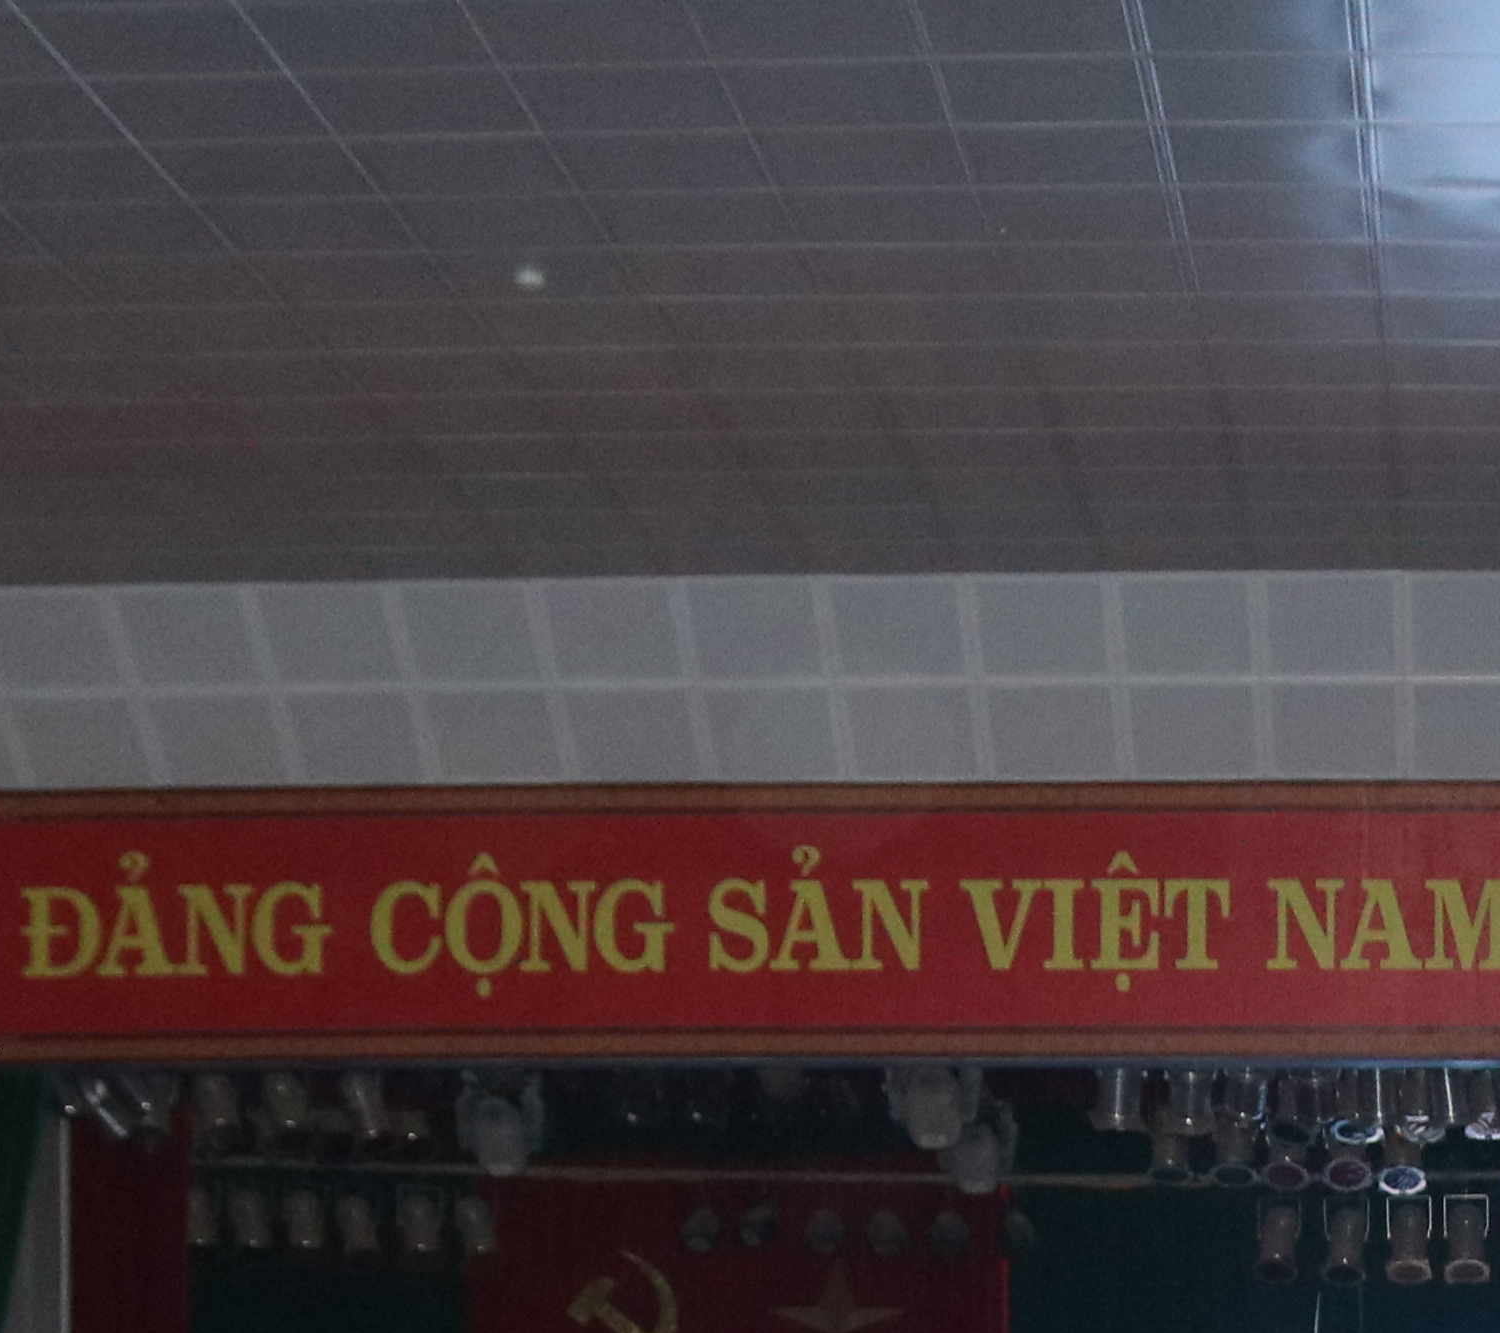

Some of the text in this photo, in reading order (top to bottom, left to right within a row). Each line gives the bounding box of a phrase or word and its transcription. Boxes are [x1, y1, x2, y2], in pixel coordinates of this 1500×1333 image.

[22, 853, 332, 977] ĐẢNG
[369, 853, 675, 997] CỘNG
[707, 846, 929, 974] SẢN
[959, 851, 1232, 991] VIỆT
